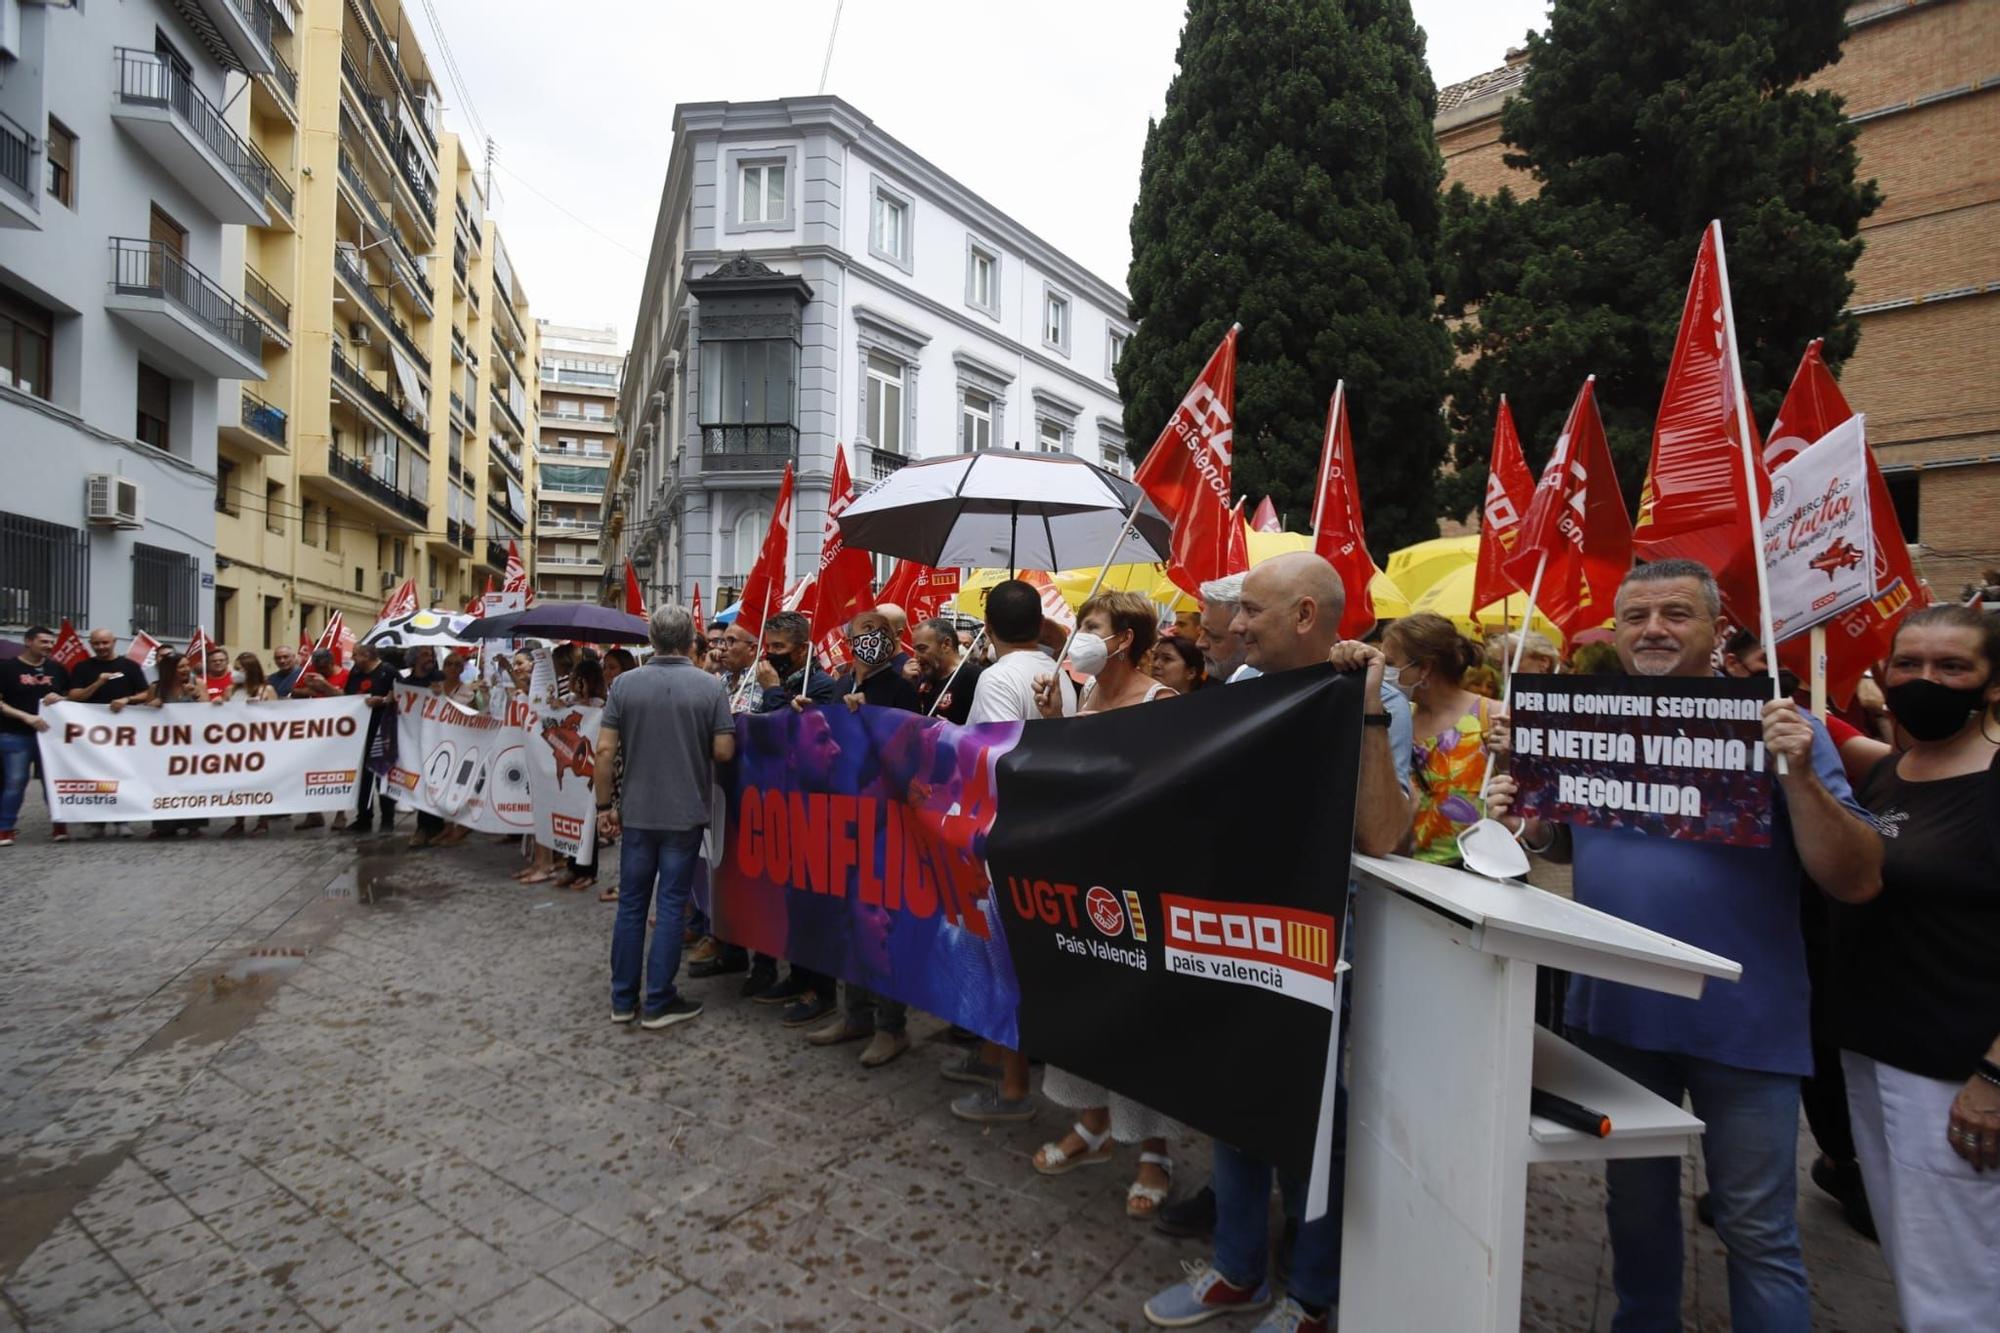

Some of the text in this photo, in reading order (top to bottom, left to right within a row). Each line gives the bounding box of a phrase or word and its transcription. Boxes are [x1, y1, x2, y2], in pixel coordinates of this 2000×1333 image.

[1515, 692, 1543, 711] PER
[1547, 693, 1570, 713] UN
[1573, 694, 1652, 717] CONVENI
[65, 723, 136, 746] POR
[150, 725, 192, 746] UN
[203, 716, 357, 744] CONVENIO
[168, 752, 265, 776] DIGNO
[1515, 727, 1765, 772] DE NETEJA VIÀRIA I
[308, 773, 346, 783] CCOO
[153, 789, 273, 810] SECTOR PLÁSTICO
[1559, 775, 1701, 817] RECOLLIDA
[1009, 876, 1077, 928] UGT
[1170, 906, 1284, 955] CCOO
[1086, 939, 1148, 971] Valencià
[1210, 961, 1284, 989] valencià
